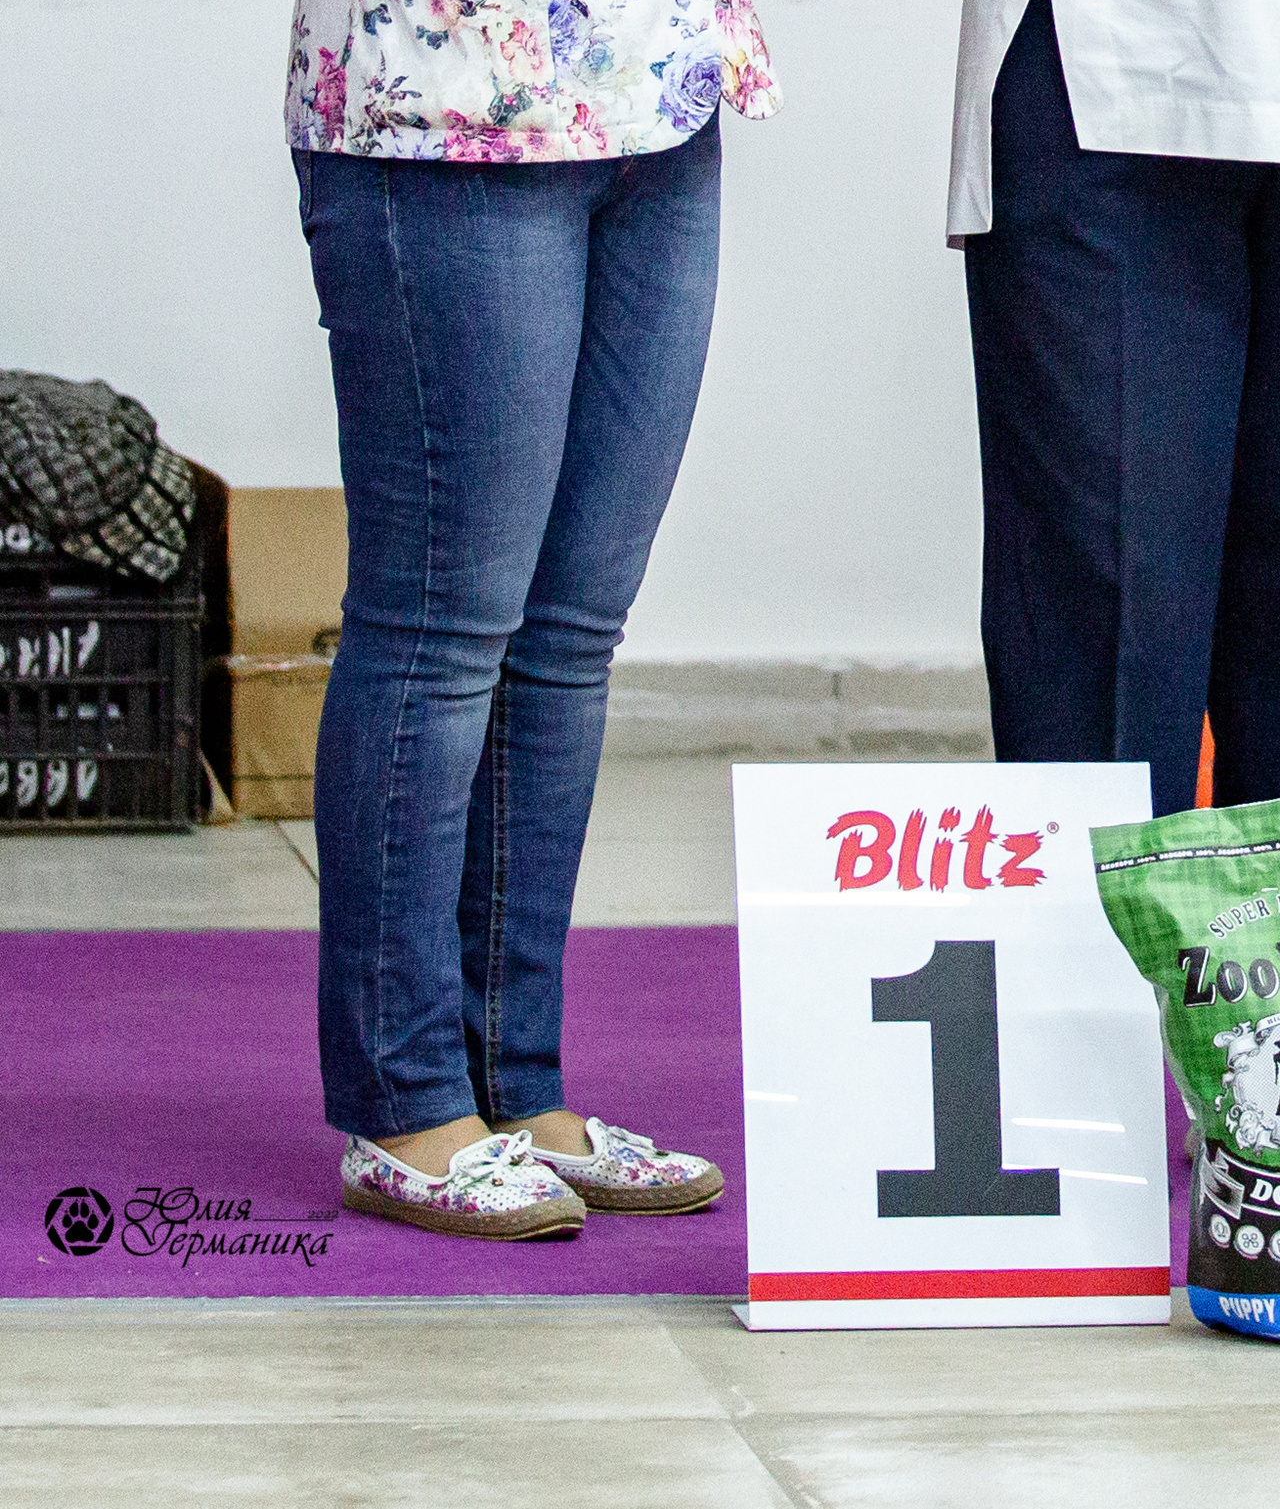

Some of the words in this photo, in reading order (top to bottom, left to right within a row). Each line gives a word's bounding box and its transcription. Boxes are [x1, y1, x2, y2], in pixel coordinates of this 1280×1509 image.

[826, 804, 1048, 893] Blitz
[1209, 898, 1271, 939] SUPER
[870, 940, 1061, 1218] 1
[1218, 1295, 1276, 1324] PUPPY
